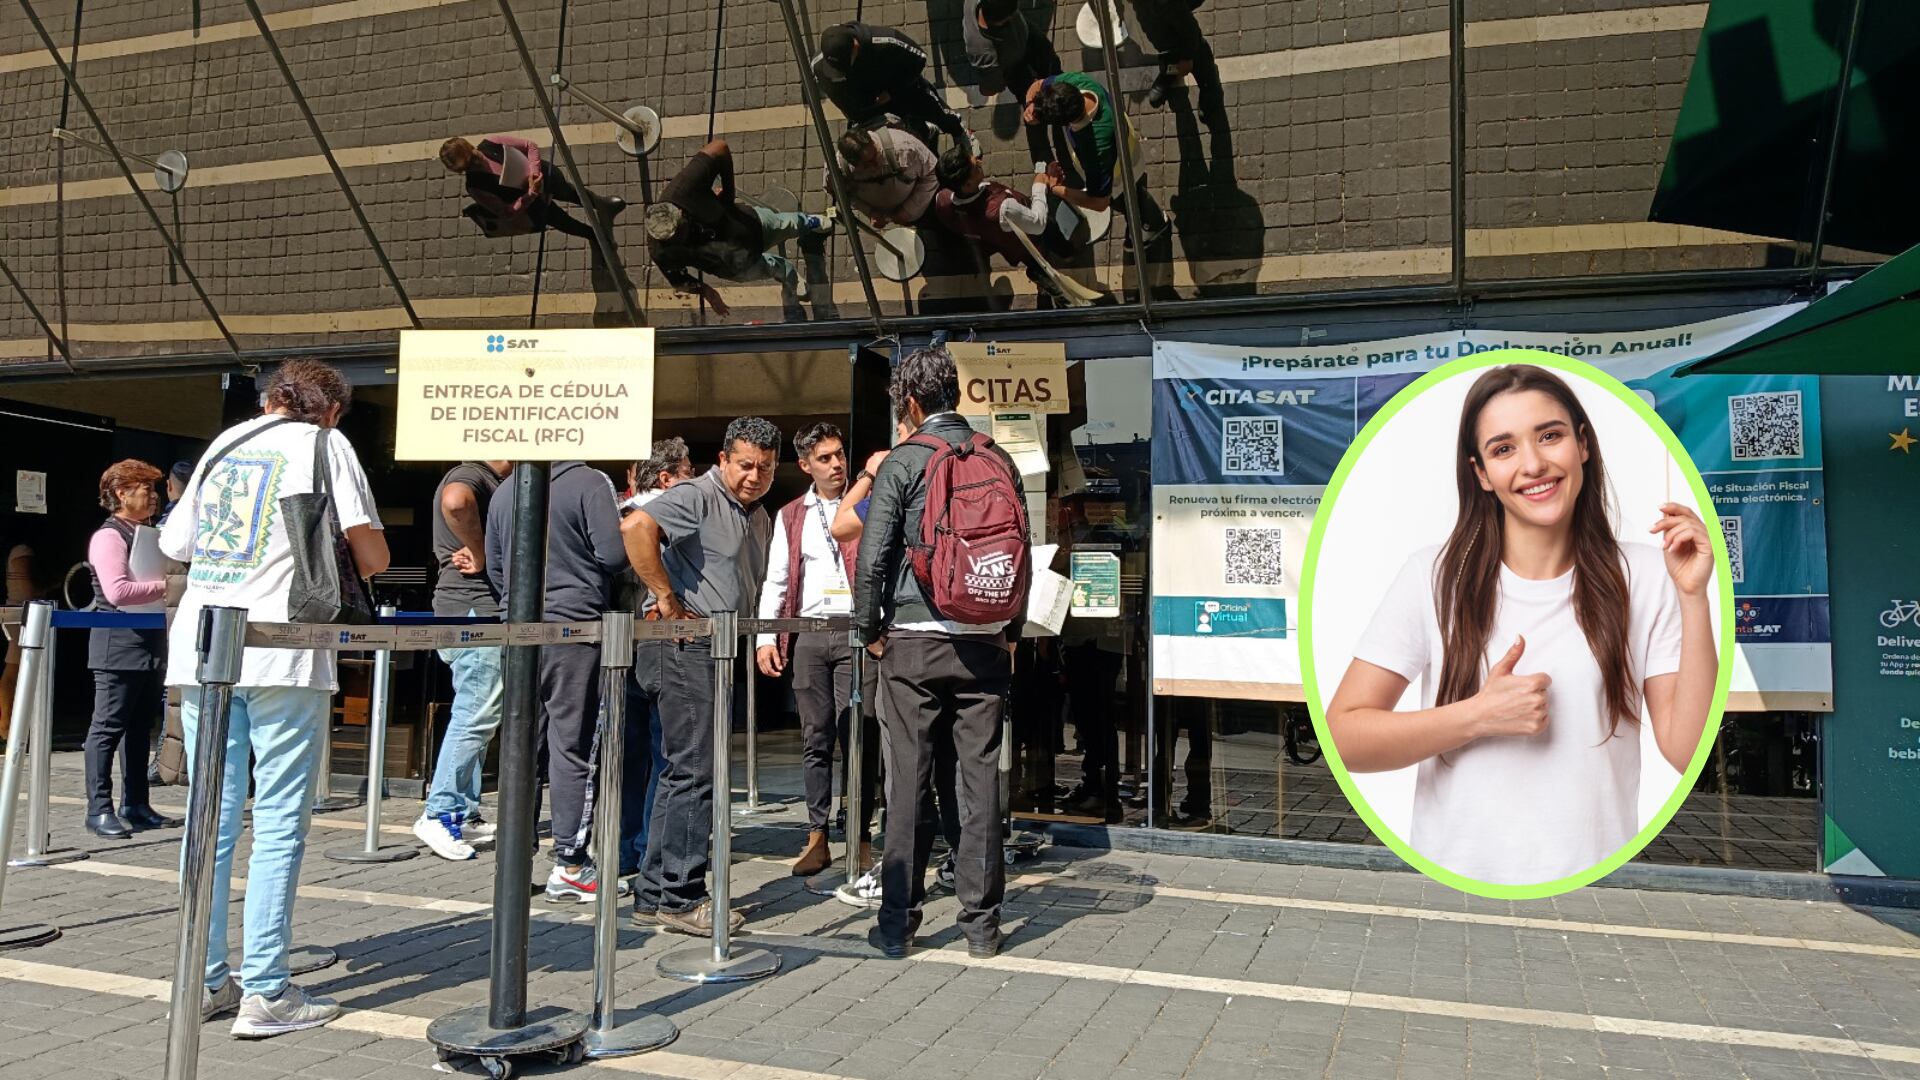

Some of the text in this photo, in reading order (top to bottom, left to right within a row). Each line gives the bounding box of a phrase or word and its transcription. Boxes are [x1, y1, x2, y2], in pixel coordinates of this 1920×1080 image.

[507, 339, 539, 348] SAT
[1241, 354, 1359, 371] ¡Prepárate
[1366, 349, 1418, 368] para
[1425, 345, 1450, 360] tu
[1609, 333, 1692, 354] Anual!
[422, 380, 629, 399] ENTREGA DE CÉDULA
[966, 378, 1051, 403] CITAS
[1205, 389, 1315, 405] CITASAT
[430, 403, 619, 420] DE IDENTIFICACIÓN
[462, 427, 585, 445] FISCAL (RFC)
[1709, 480, 1809, 493] de Situación Fiscal
[1169, 495, 1218, 505] Renueva
[1221, 495, 1232, 504] tu
[1235, 494, 1268, 504] firma
[1742, 492, 1806, 503] electrónica.
[1200, 507, 1304, 519] próxima a vencer.
[967, 550, 1015, 577] VANS
[968, 587, 983, 596] OFF
[984, 590, 999, 599] THE
[1220, 603, 1248, 612] Oficina
[1211, 612, 1248, 622] Virtual
